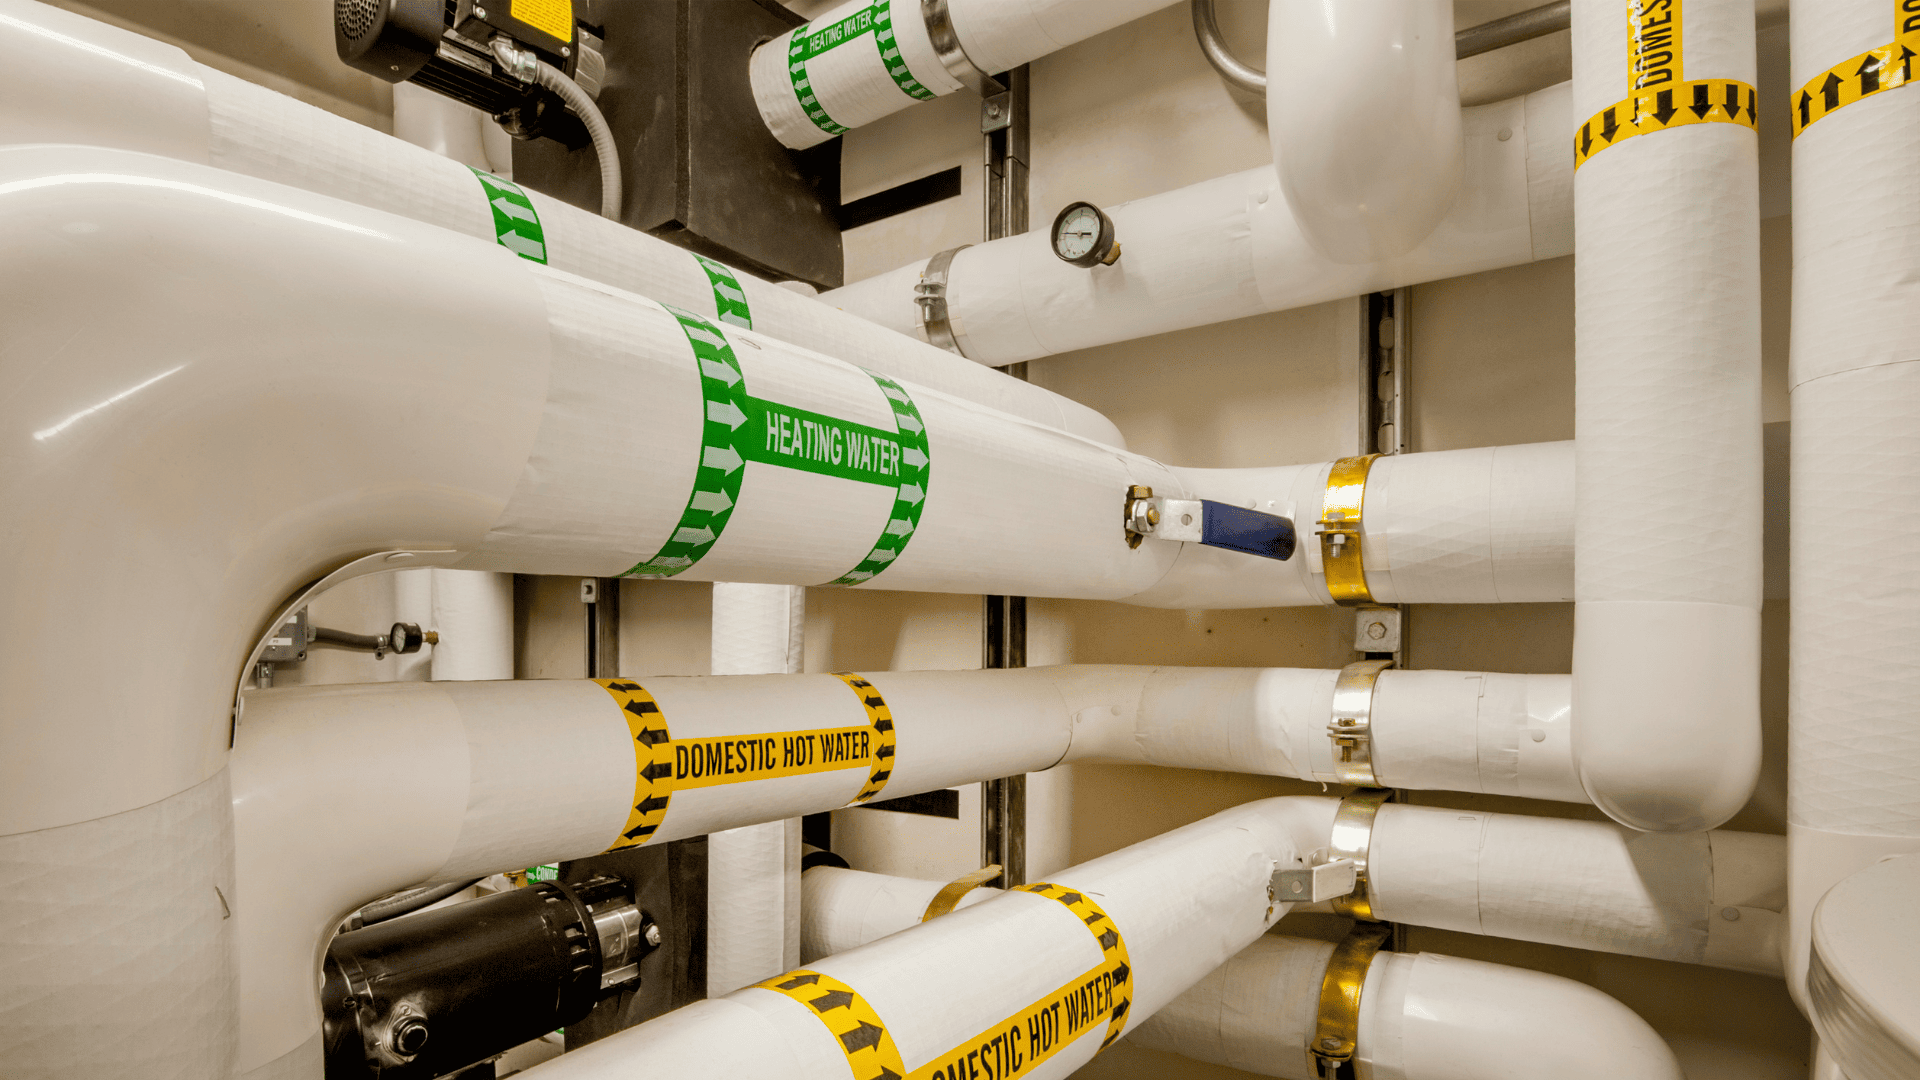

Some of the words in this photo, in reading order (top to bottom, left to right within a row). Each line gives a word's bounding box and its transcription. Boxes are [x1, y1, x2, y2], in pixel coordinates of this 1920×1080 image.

[809, 23, 842, 54] HEATING
[843, 9, 872, 37] WATER
[766, 410, 843, 465] HEATING
[845, 430, 900, 477] WATER
[675, 737, 777, 780] DOMESTIC
[782, 735, 815, 768] HOT
[819, 730, 870, 763] WATER
[932, 1025, 1023, 1080] ESTIC
[1027, 1001, 1061, 1062] HOT
[1063, 971, 1114, 1036] WATER
